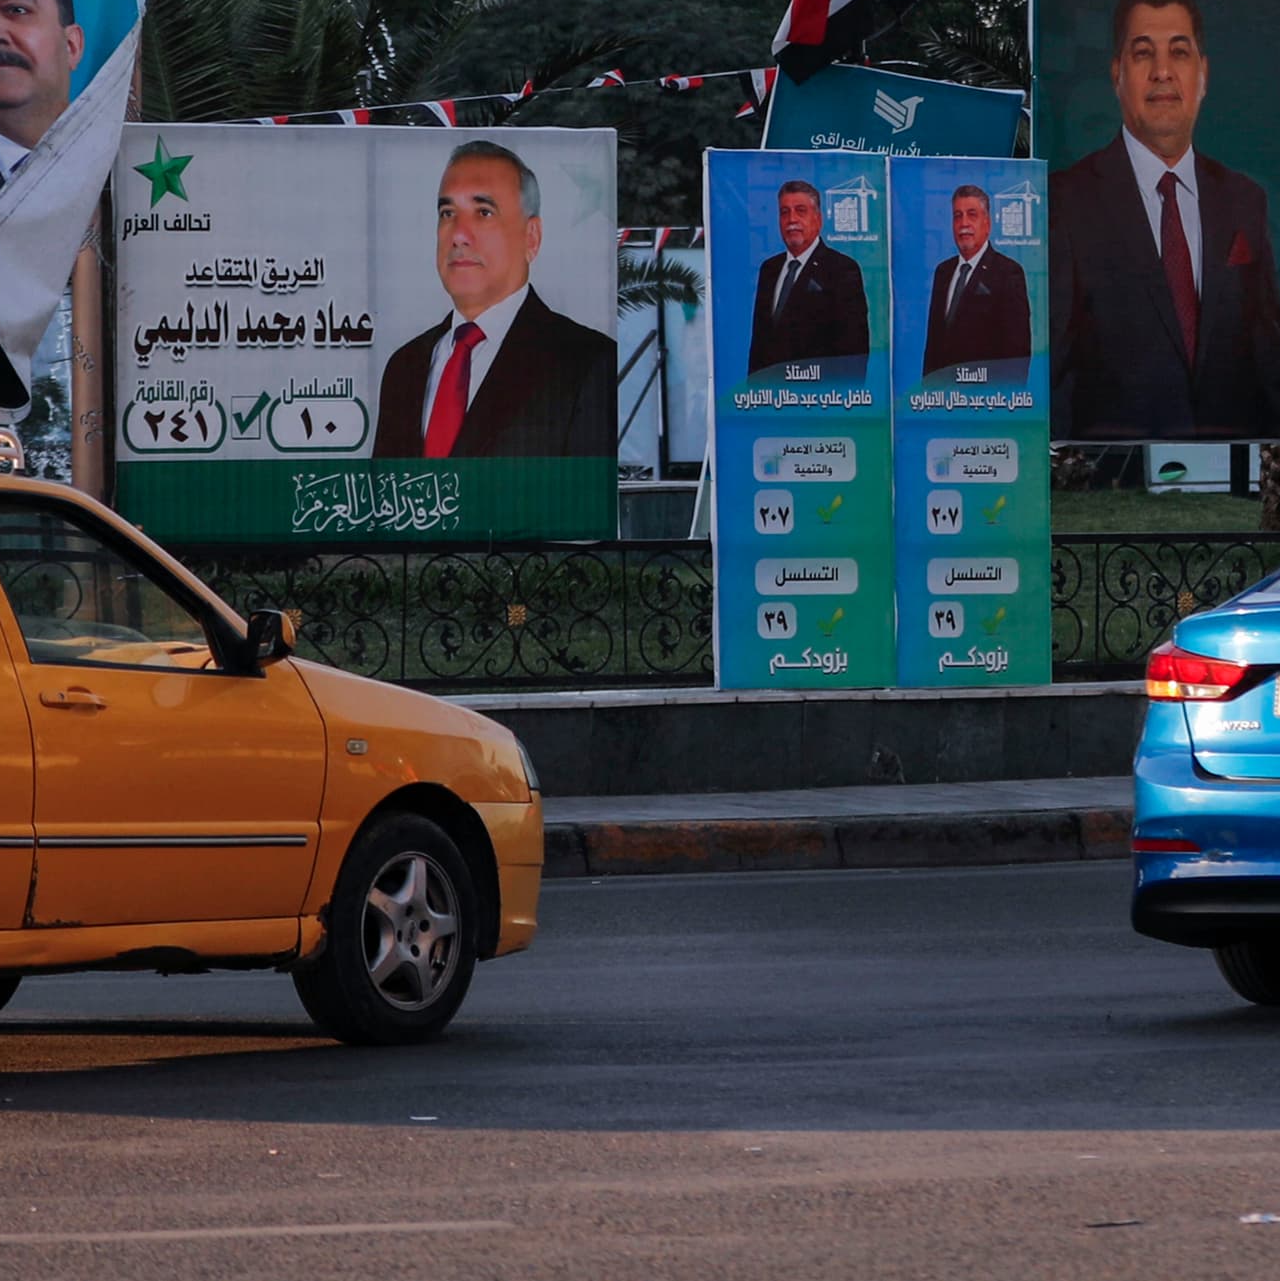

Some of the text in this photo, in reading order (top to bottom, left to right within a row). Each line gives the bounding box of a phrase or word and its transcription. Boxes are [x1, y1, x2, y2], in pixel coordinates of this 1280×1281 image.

[811, 131, 866, 151] العراقي
[121, 213, 211, 241] تحالف العزم
[185, 257, 325, 292] الفريق المتقاعد
[134, 300, 375, 367] عماد محمد الدليمي
[135, 379, 215, 416] رقم القائمة
[282, 377, 353, 404] التسلسل
[144, 408, 209, 443] ٢٤١
[301, 407, 337, 441] ١٠
[758, 505, 791, 526] ٢٠٧
[931, 506, 960, 526] ٢٠٧
[774, 564, 839, 587] التسلسل
[945, 564, 1003, 586] التسلسل
[764, 609, 790, 631] ٣٩
[934, 611, 958, 631] ٣٩
